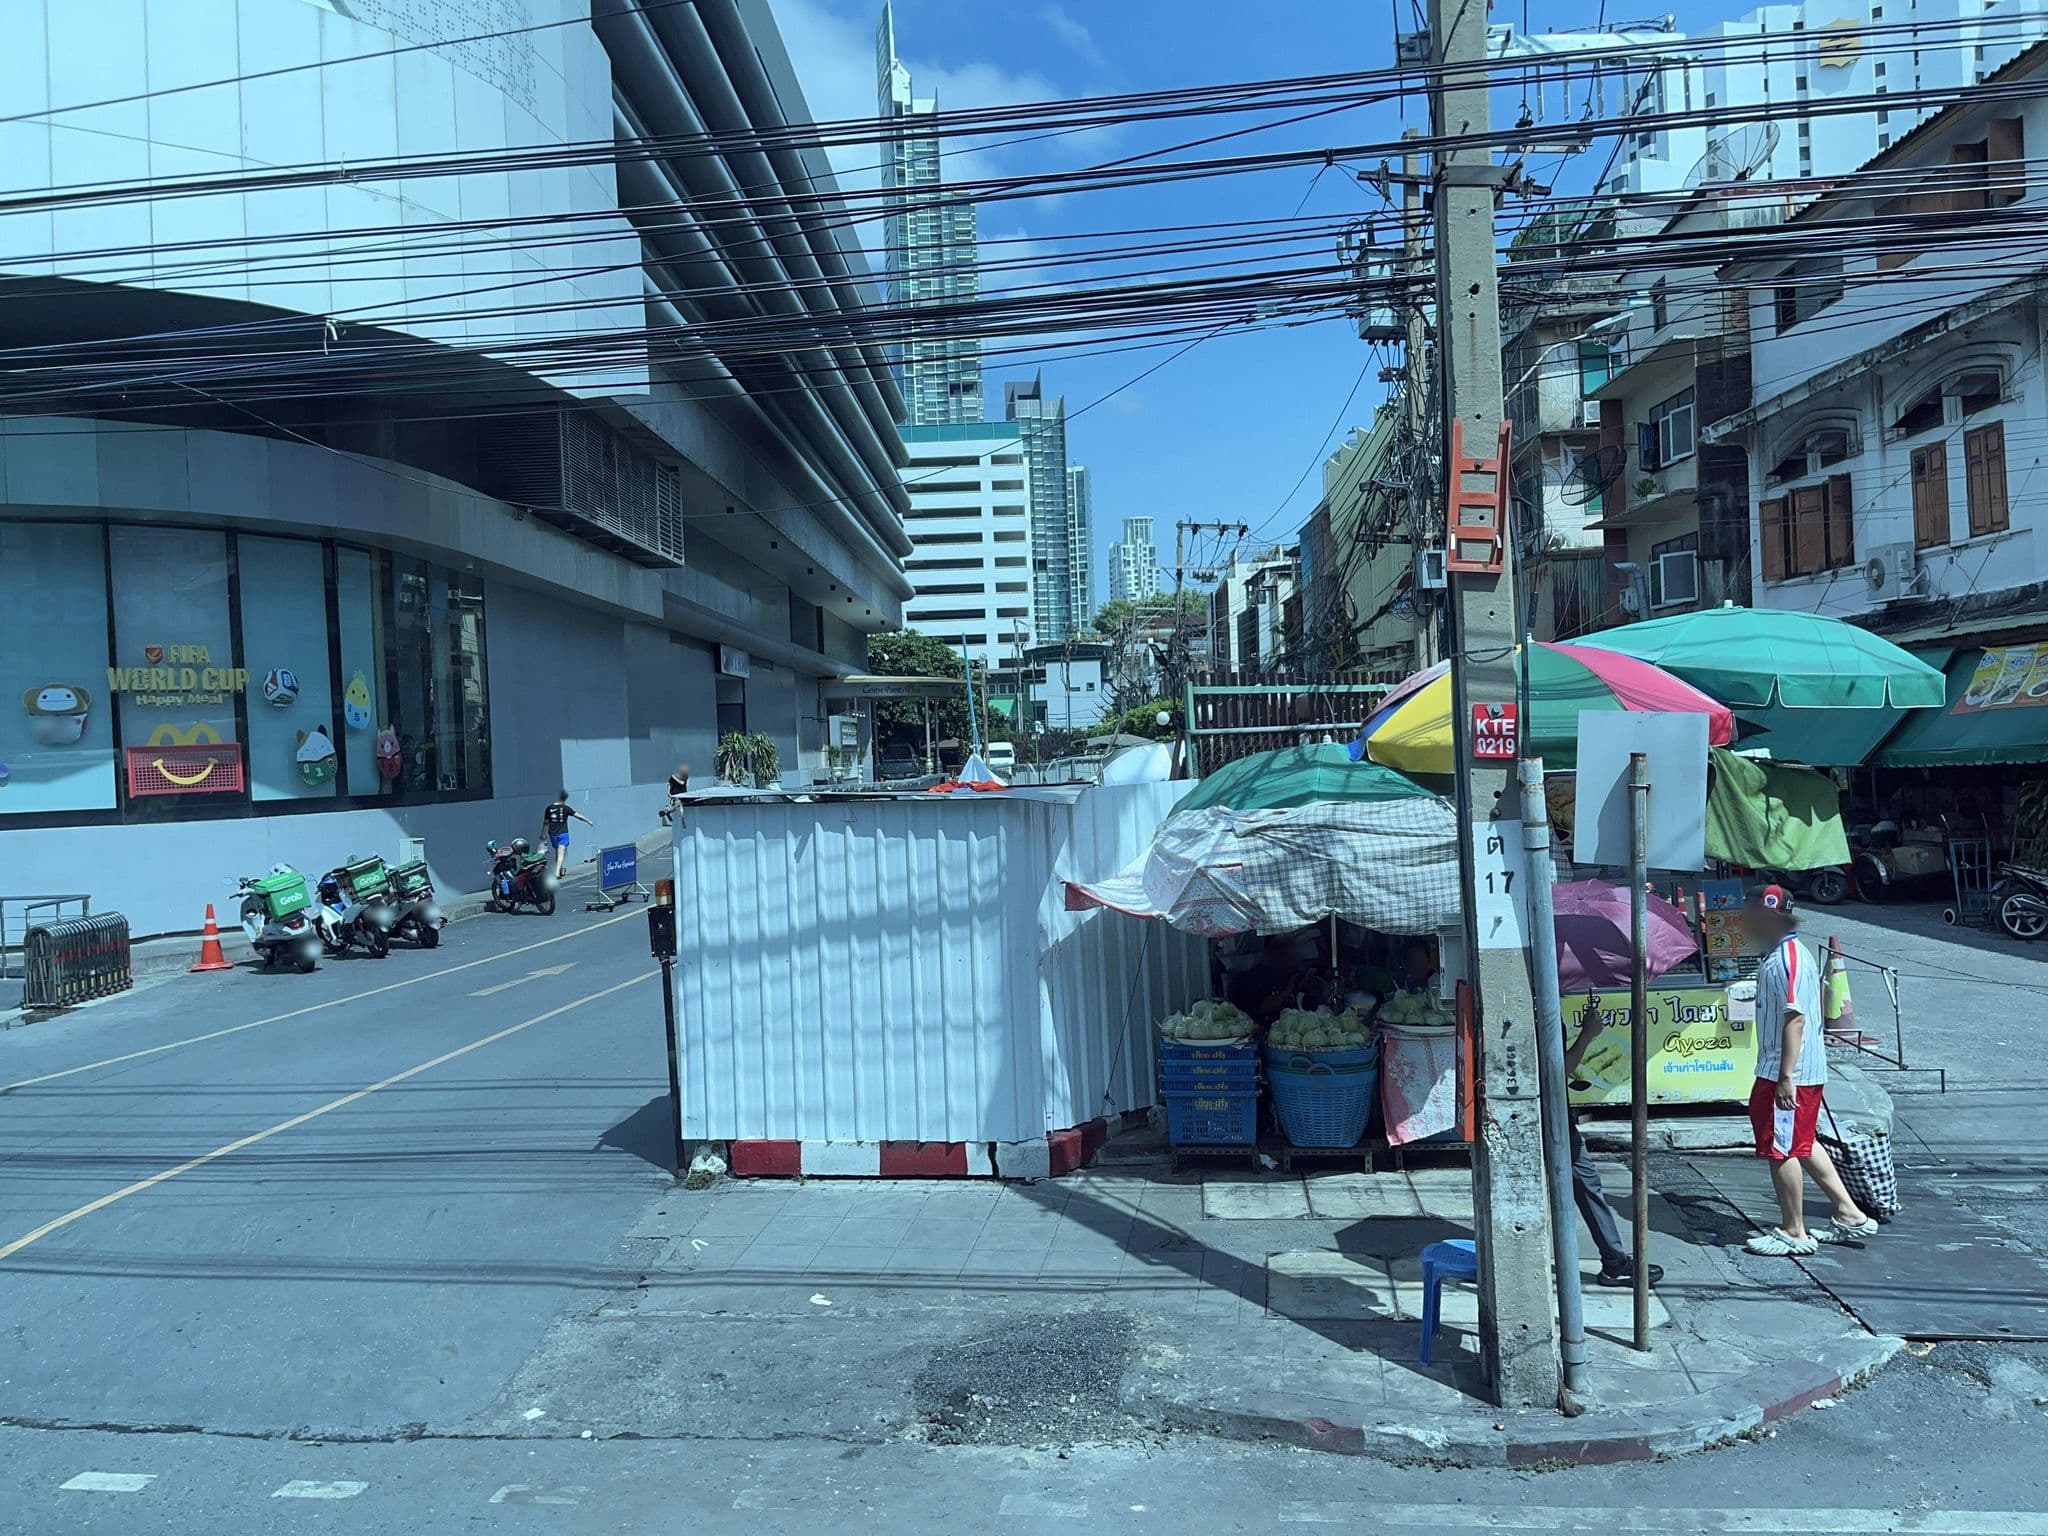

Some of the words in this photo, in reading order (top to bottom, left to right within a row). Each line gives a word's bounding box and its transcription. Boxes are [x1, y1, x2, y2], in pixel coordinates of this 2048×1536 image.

[168, 644, 210, 664] FIFA
[107, 667, 198, 692] WORLD
[202, 667, 250, 692] CUP
[135, 694, 184, 708] Happy
[187, 693, 224, 705] Meal
[1476, 718, 1516, 736] KTE
[1476, 737, 1516, 754] 0219
[1487, 835, 1504, 855] ต
[359, 873, 381, 887] Grab
[1485, 871, 1515, 894] 17
[279, 892, 303, 906] Grab
[1663, 1031, 1732, 1057] Gyoza
